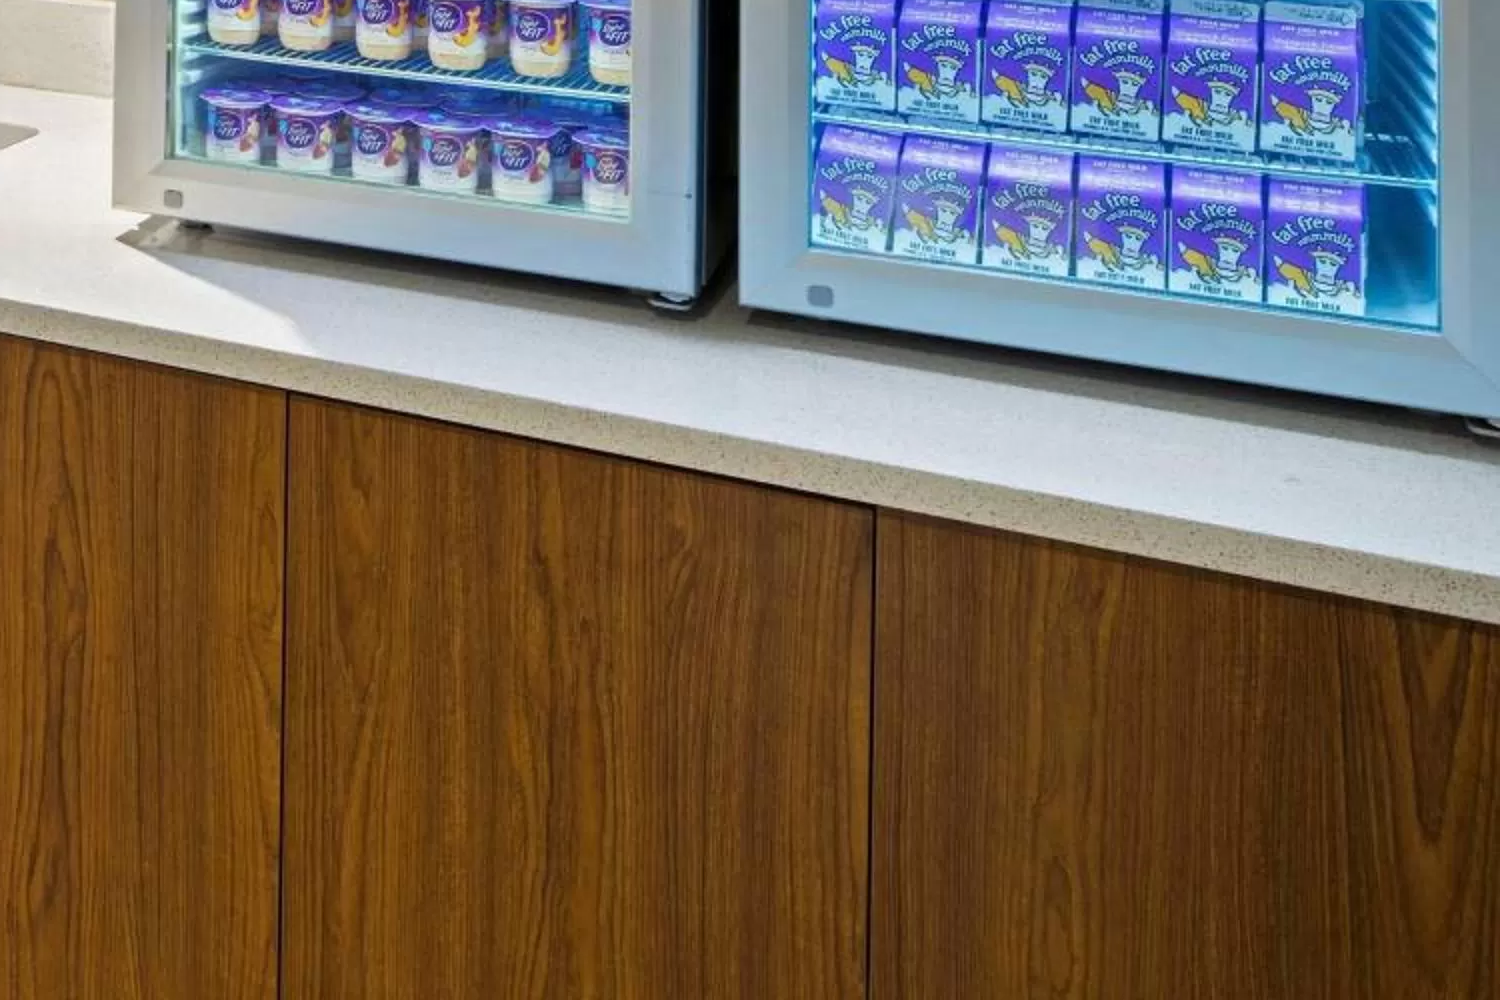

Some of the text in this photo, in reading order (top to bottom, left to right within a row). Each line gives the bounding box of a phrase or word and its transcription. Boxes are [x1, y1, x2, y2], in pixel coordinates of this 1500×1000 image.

[819, 14, 871, 41] fat free
[901, 24, 955, 51] fat free
[990, 32, 1046, 59] fat free
[1080, 39, 1137, 66] fat free
[1170, 47, 1231, 75] fat free
[1269, 55, 1331, 84] fat free
[991, 183, 1048, 210] fat free
[1081, 193, 1140, 221] fat free
[1176, 203, 1237, 231] fat free
[1271, 216, 1334, 244] fat free
